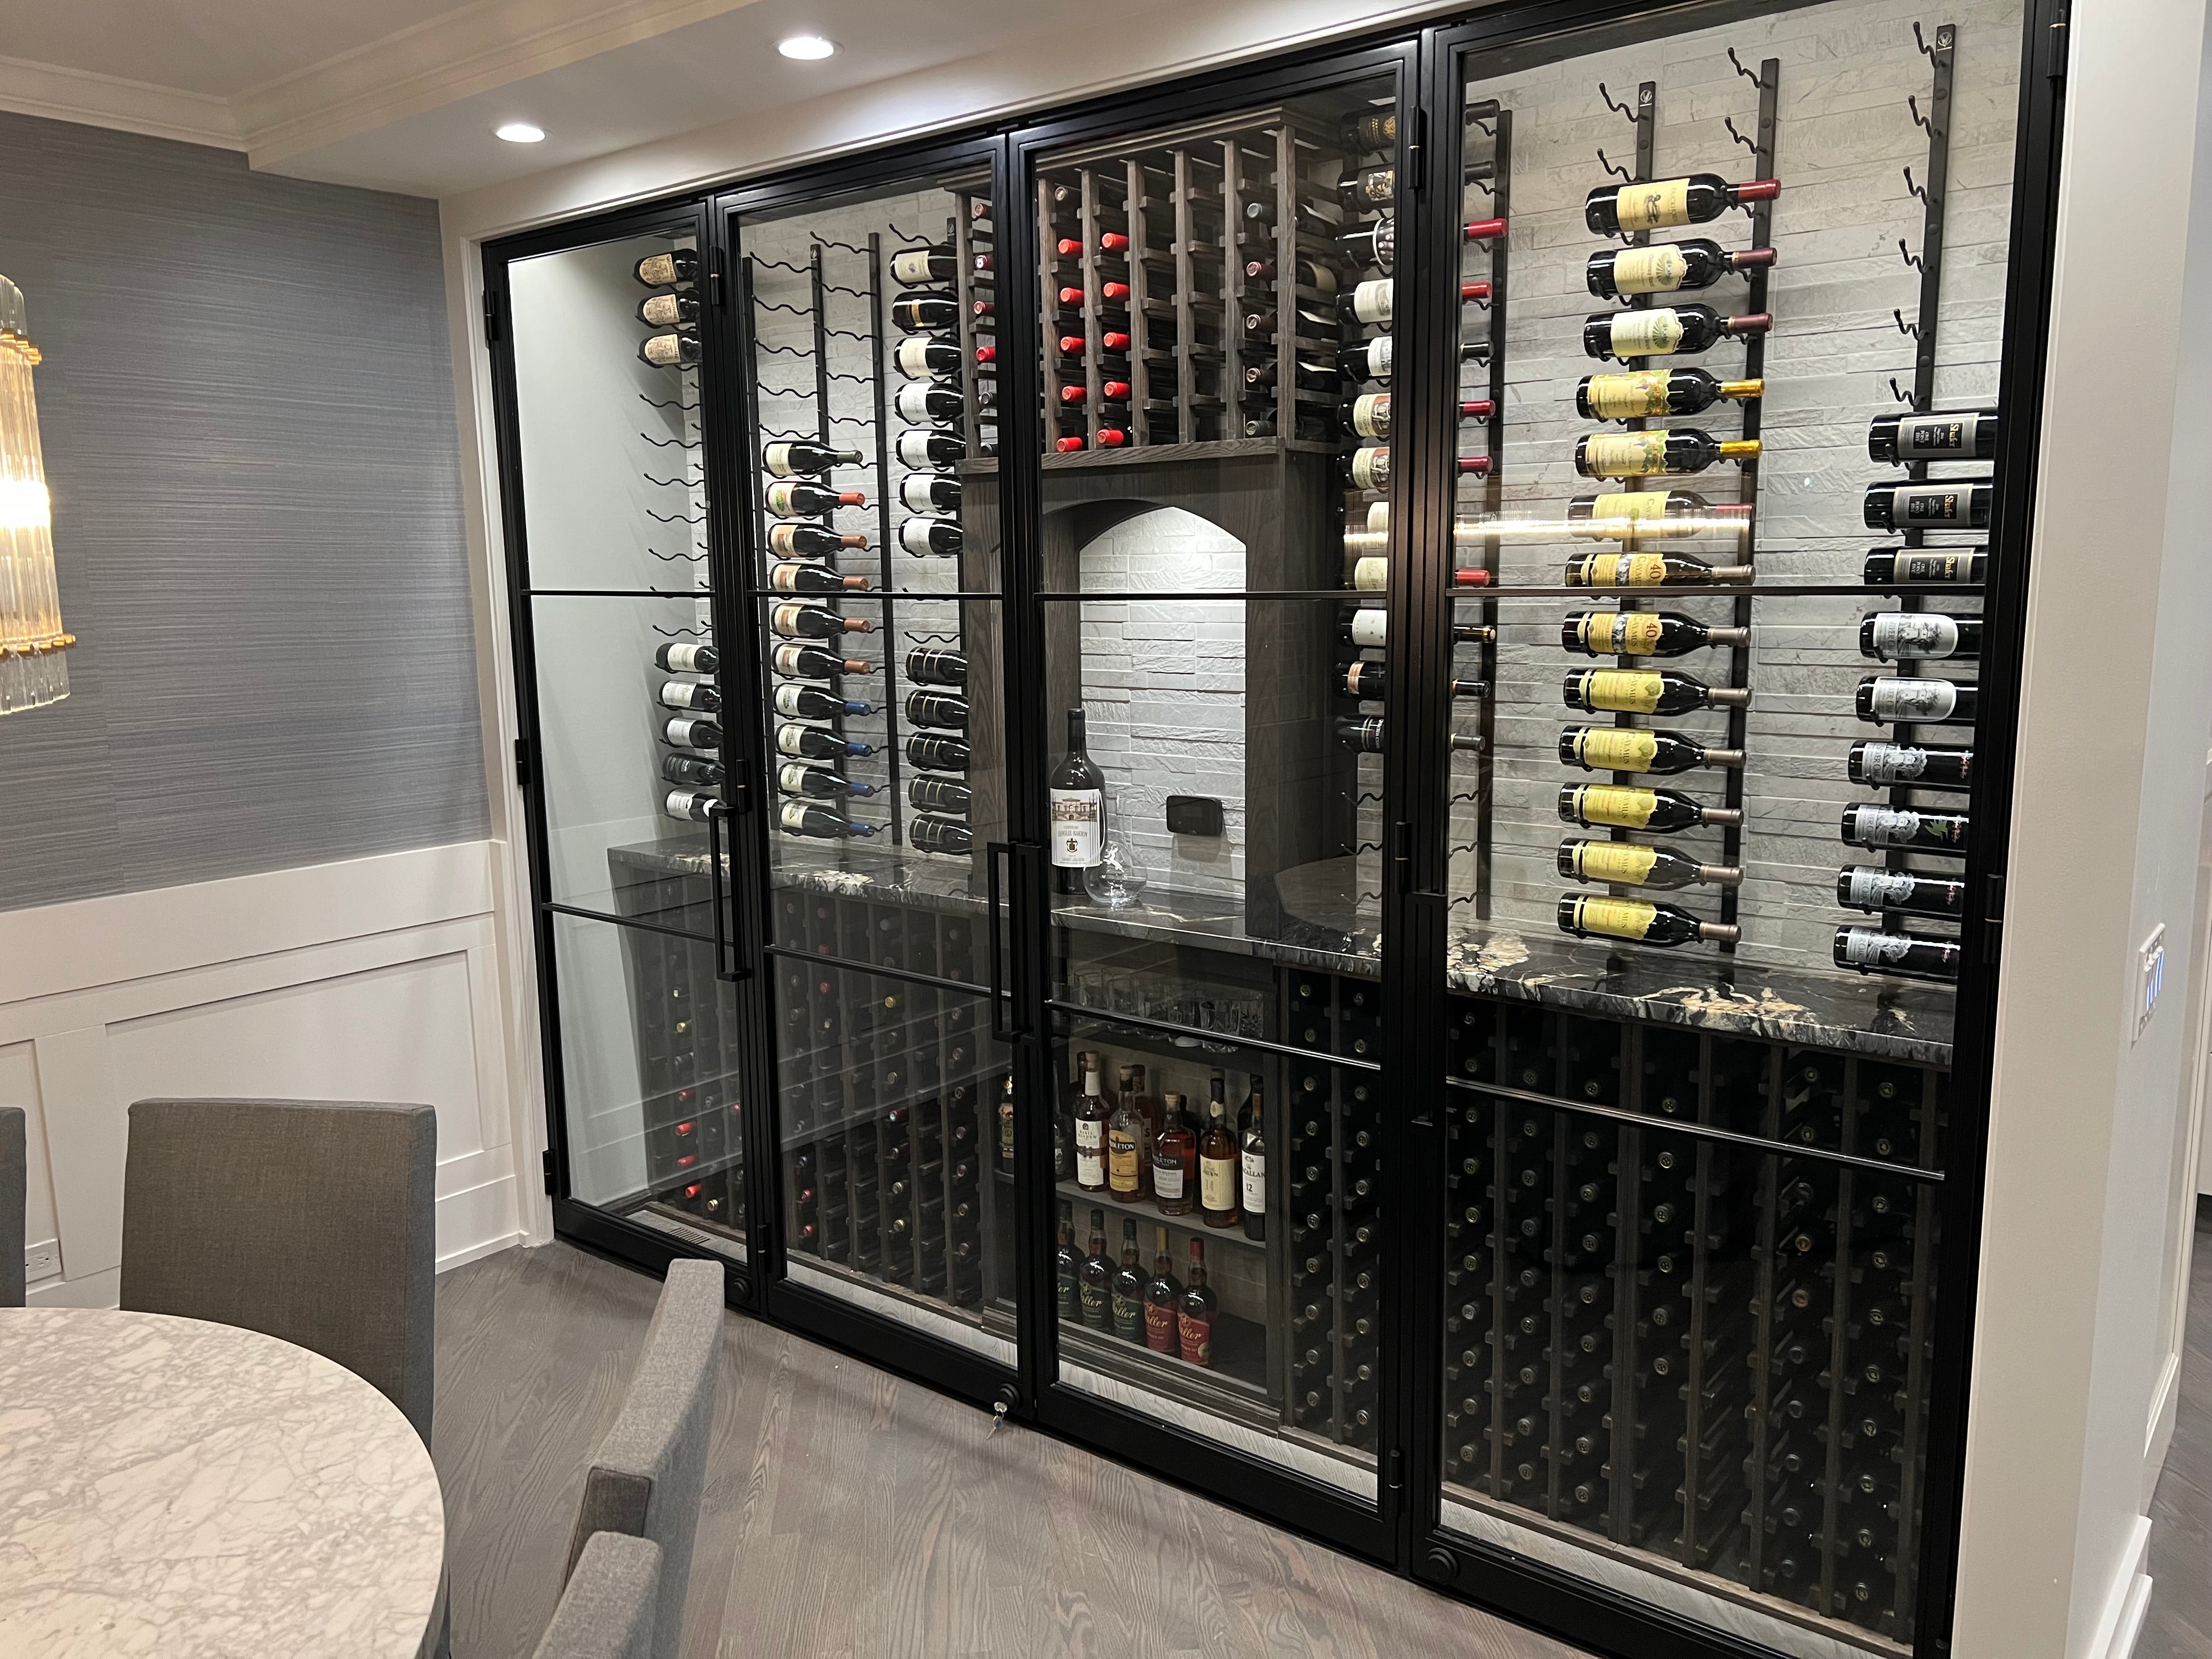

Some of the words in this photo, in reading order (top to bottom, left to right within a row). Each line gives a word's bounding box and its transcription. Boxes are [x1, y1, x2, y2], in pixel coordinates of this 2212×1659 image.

[1949, 424, 1959, 448] Shafer
[1944, 495, 1954, 518] Shafer
[1635, 556, 1647, 587] CAYMU
[1650, 564, 1662, 579] 40
[1944, 556, 1955, 580] Shafer
[1630, 615, 1643, 646] CAYMUS
[1646, 623, 1657, 637] 40
[1629, 672, 1643, 704] CAYMUS
[1623, 732, 1636, 765] CAYMUS
[1873, 764, 1882, 778] OAK
[1622, 788, 1636, 819] CAYMUS
[1622, 844, 1636, 874] CAYMUS
[1109, 1141, 1135, 1150] DLETON
[1154, 1156, 1177, 1165] LETON
[1205, 1179, 1214, 1191] 14
[1246, 1183, 1253, 1192] 12
[1081, 1295, 1103, 1307] eller
[1113, 1306, 1136, 1318] eller
[1146, 1316, 1168, 1328] eller
[1180, 1327, 1202, 1340] eller
